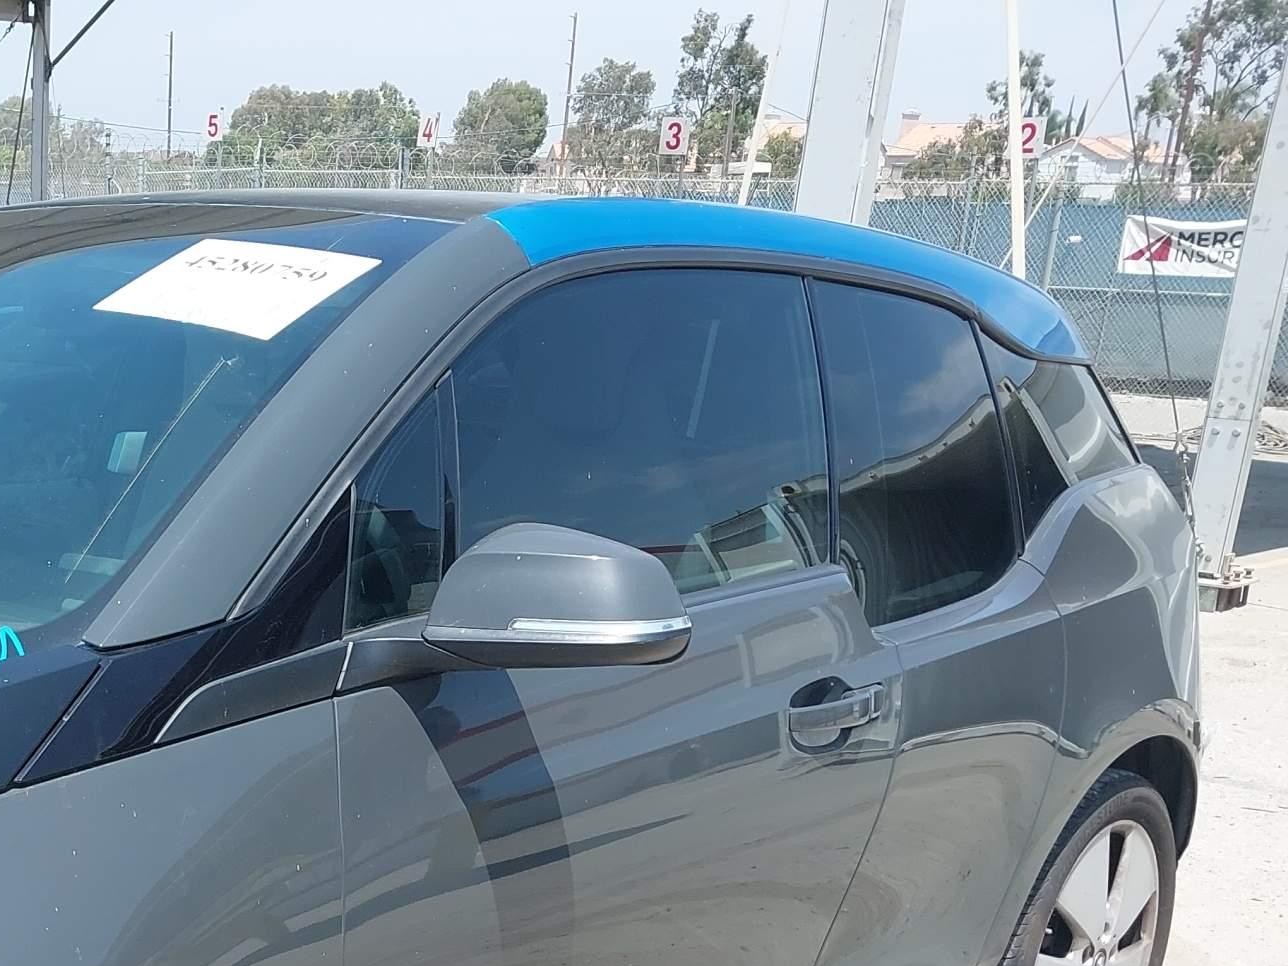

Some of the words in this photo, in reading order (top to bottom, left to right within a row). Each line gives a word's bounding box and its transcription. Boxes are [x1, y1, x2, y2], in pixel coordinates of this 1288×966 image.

[207, 114, 218, 137] 5
[422, 117, 433, 143] 4
[665, 122, 682, 150] 3
[1022, 122, 1037, 154] 2
[185, 256, 328, 282] 45280759
[1174, 248, 1239, 264] INSUR
